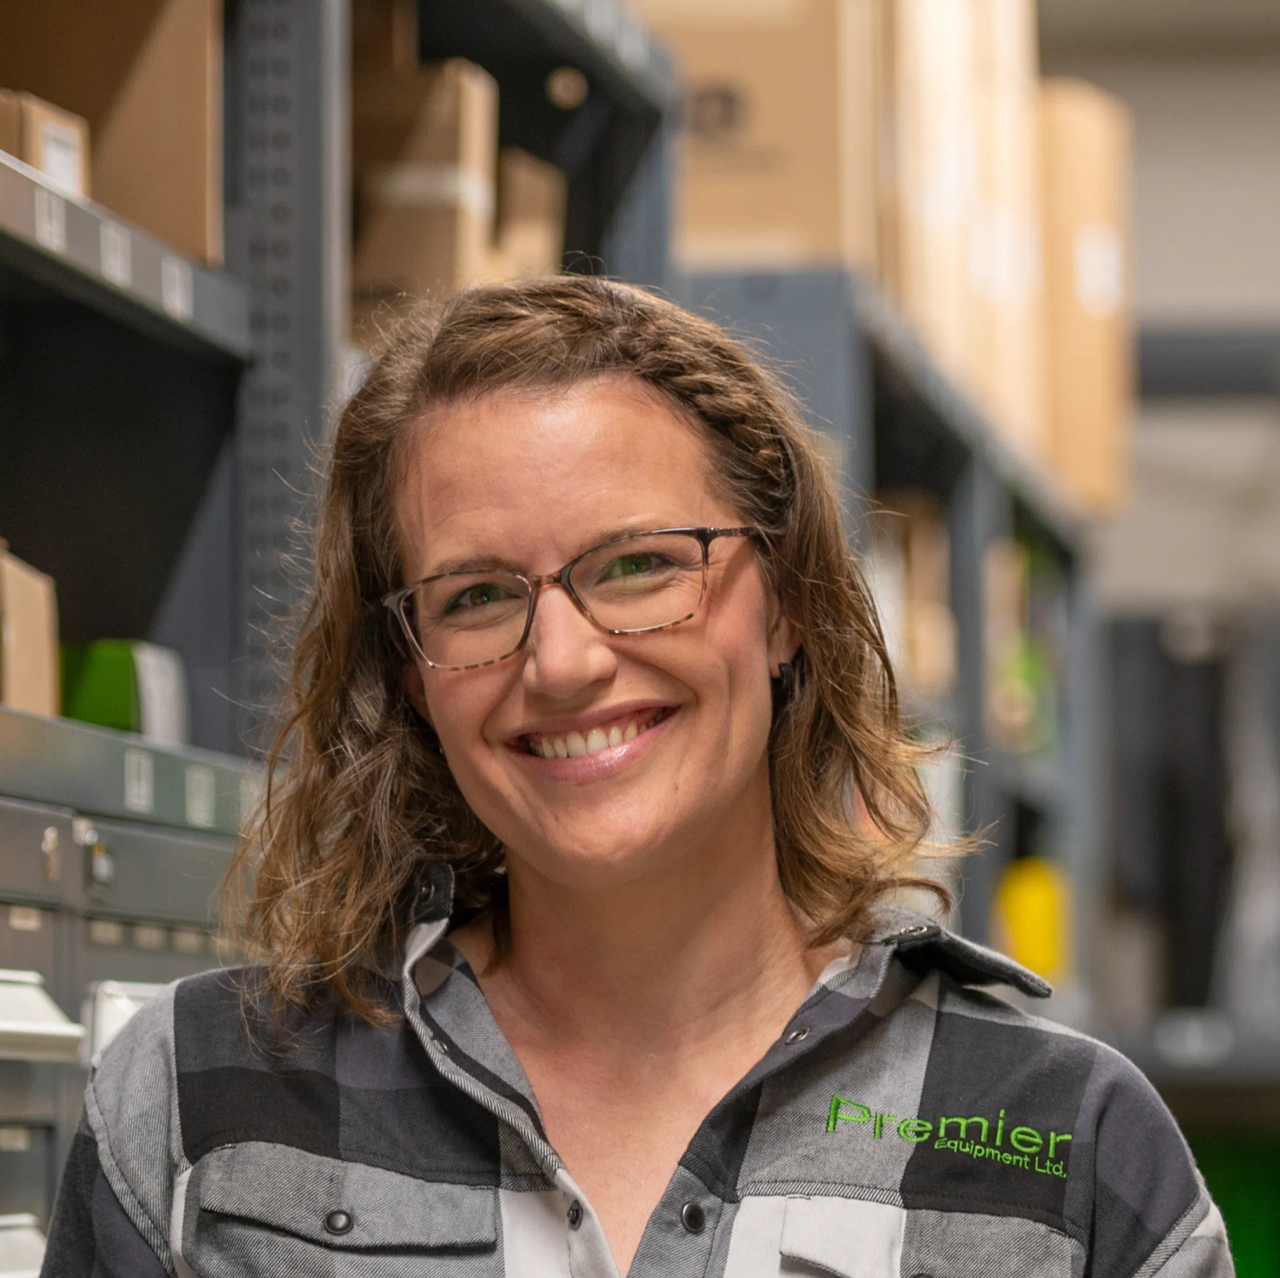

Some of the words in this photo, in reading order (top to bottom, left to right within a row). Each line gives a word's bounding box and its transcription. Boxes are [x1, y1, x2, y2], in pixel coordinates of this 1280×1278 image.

[825, 1094, 1073, 1158] Premier
[933, 1137, 1031, 1170] Equipment
[1034, 1156, 1068, 1179] Ltd.
